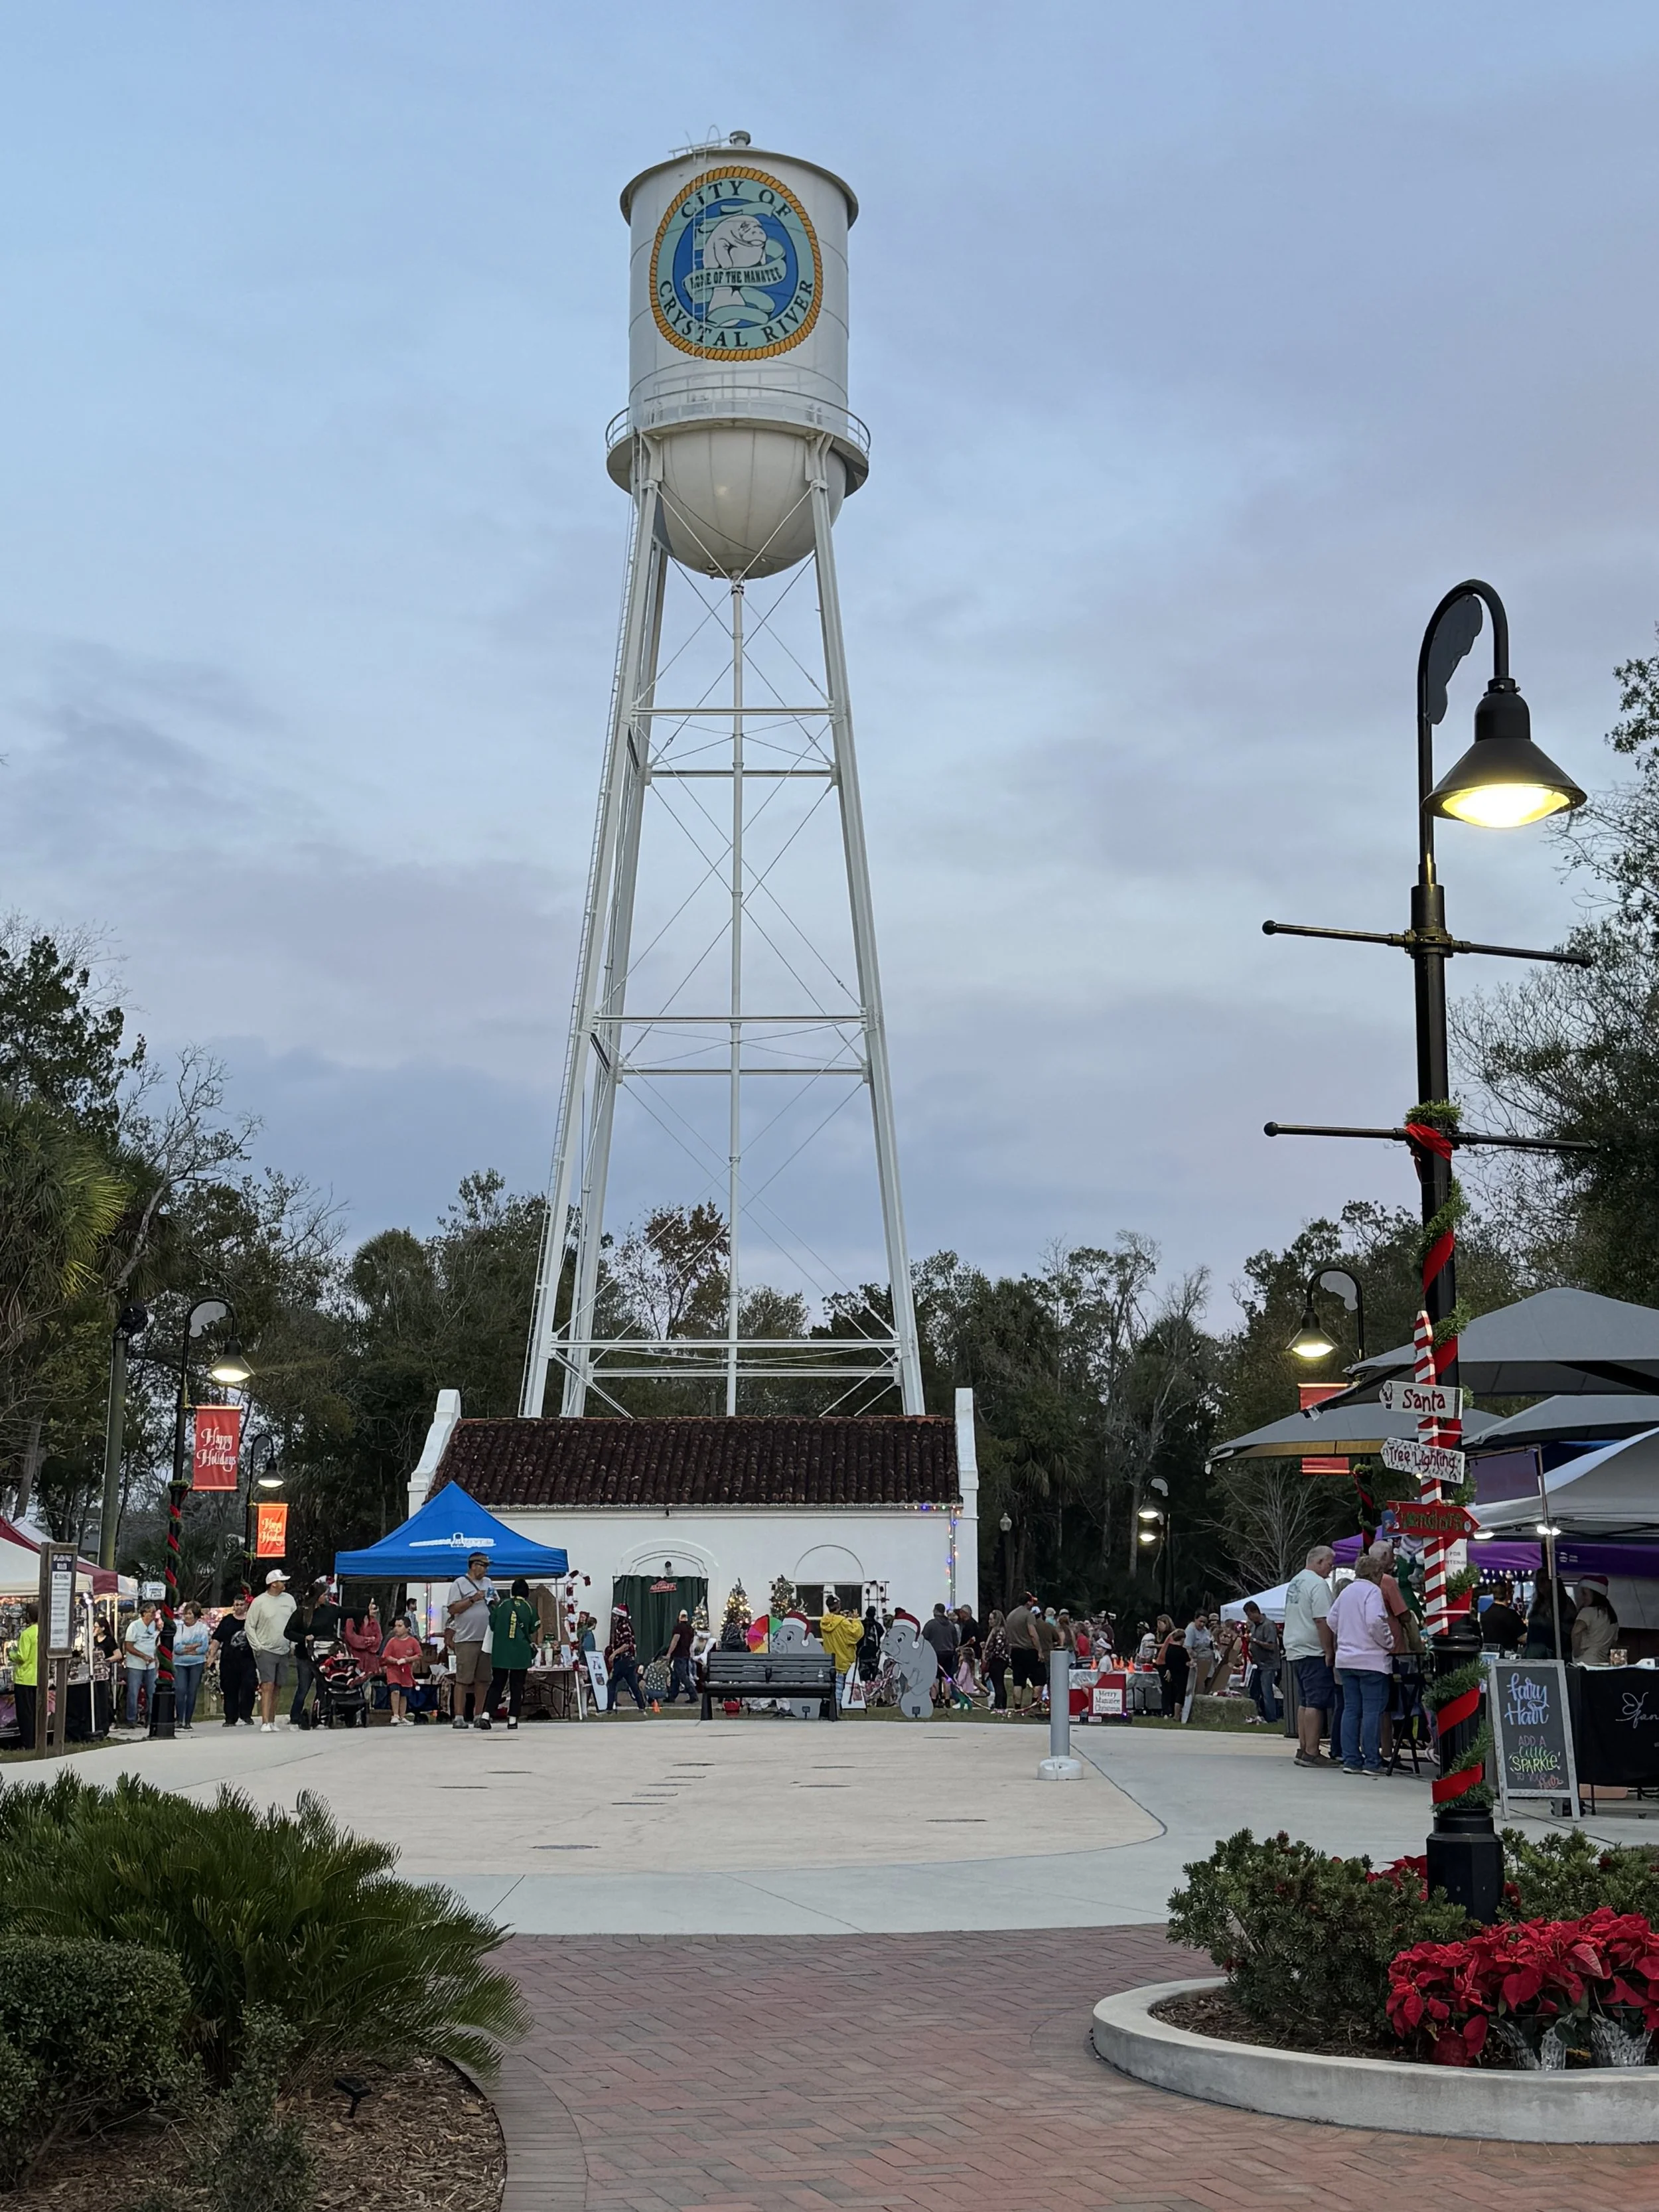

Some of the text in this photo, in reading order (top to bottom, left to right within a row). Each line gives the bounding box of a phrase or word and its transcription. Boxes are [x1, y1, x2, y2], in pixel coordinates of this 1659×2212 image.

[681, 180, 792, 219] CITY OF
[713, 271, 724, 284] OF
[726, 270, 743, 284] THE
[744, 267, 782, 283] MANATEE
[659, 280, 814, 347] CRYSTAL RIVER
[1402, 1388, 1446, 1412] Santa
[200, 1427, 234, 1451] Happy
[196, 1449, 236, 1473] Holidays
[1390, 1447, 1457, 1475] Tree Lighting
[1518, 1735, 1547, 1747] ADD A
